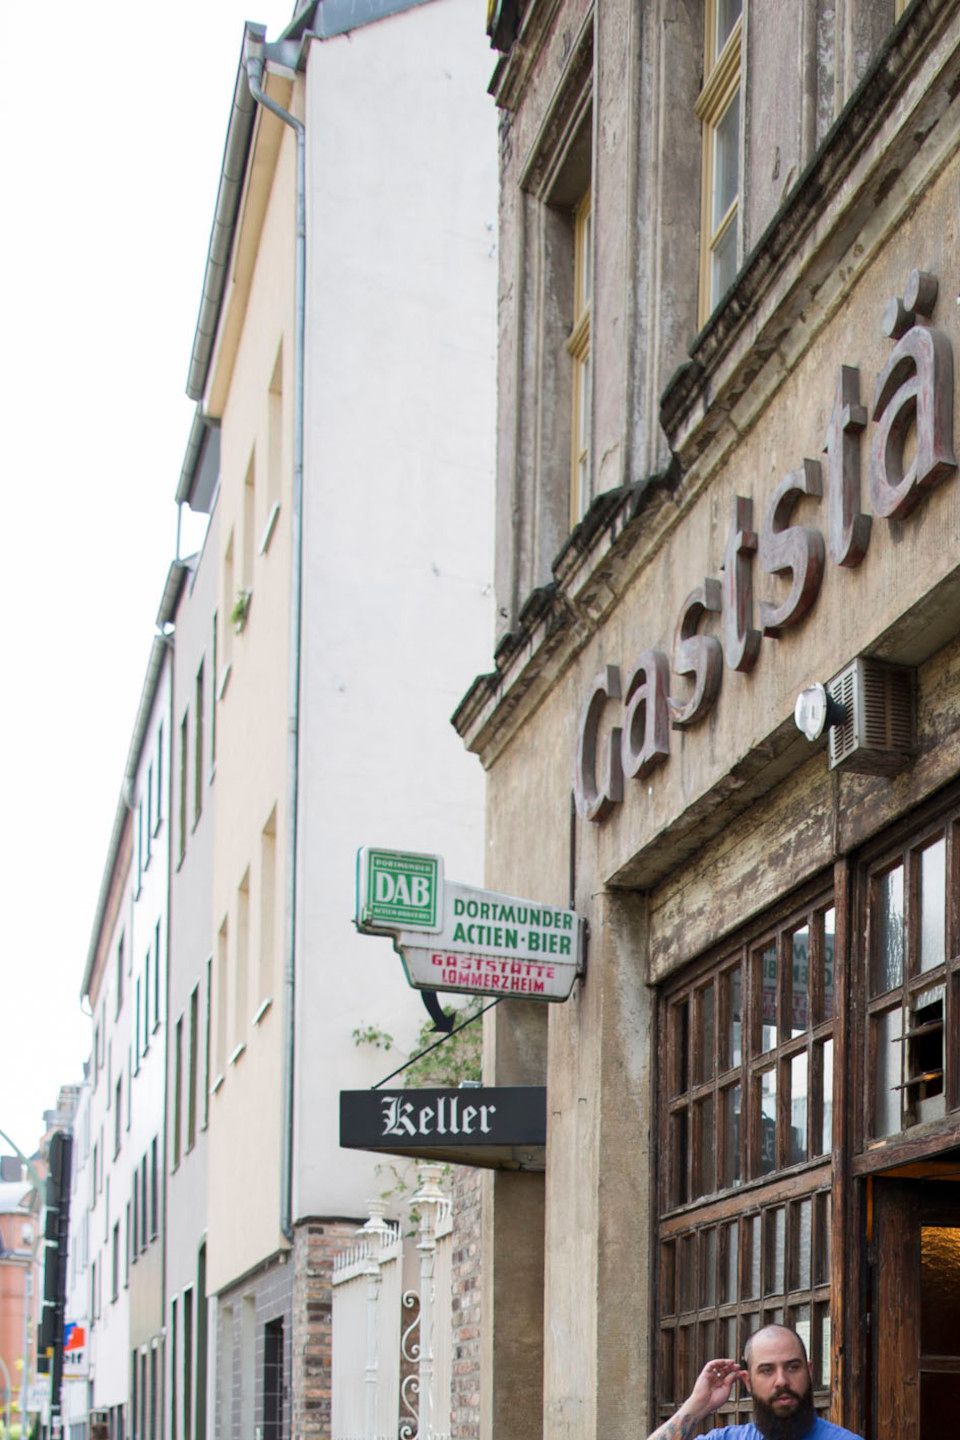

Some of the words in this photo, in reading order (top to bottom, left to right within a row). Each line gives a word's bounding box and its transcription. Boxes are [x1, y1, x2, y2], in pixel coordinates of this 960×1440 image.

[375, 871, 430, 908] DAB
[454, 898, 573, 930] DORTMUNDER
[442, 968, 545, 993] LOMMERZHEIM
[381, 1095, 497, 1137] Keller
